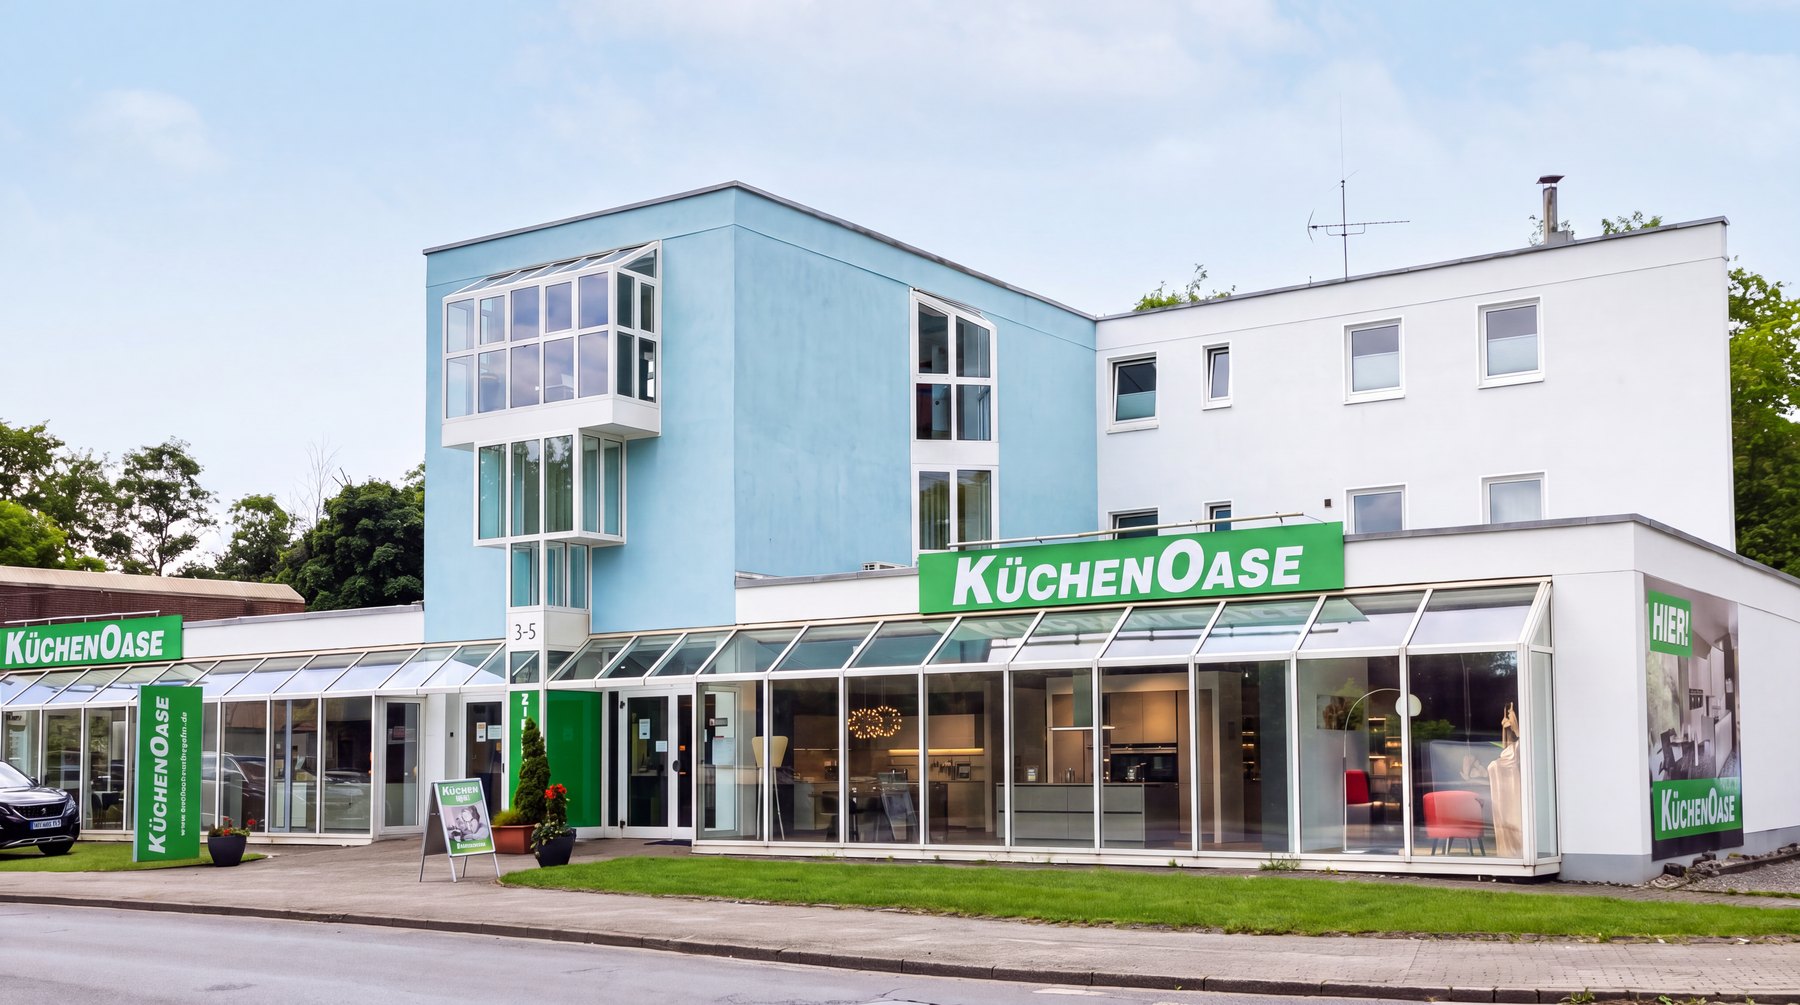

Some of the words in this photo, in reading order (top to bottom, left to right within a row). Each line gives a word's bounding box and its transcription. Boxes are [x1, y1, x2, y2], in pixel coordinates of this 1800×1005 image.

[953, 539, 1304, 605] KÜCHENOASE
[5, 624, 164, 664] KÜCHENOASE
[515, 623, 536, 640] 3-5
[1653, 602, 1689, 646] HIER!
[148, 696, 169, 853] KÜCHENOASE
[1661, 787, 1735, 832] KÜCHENOASE
